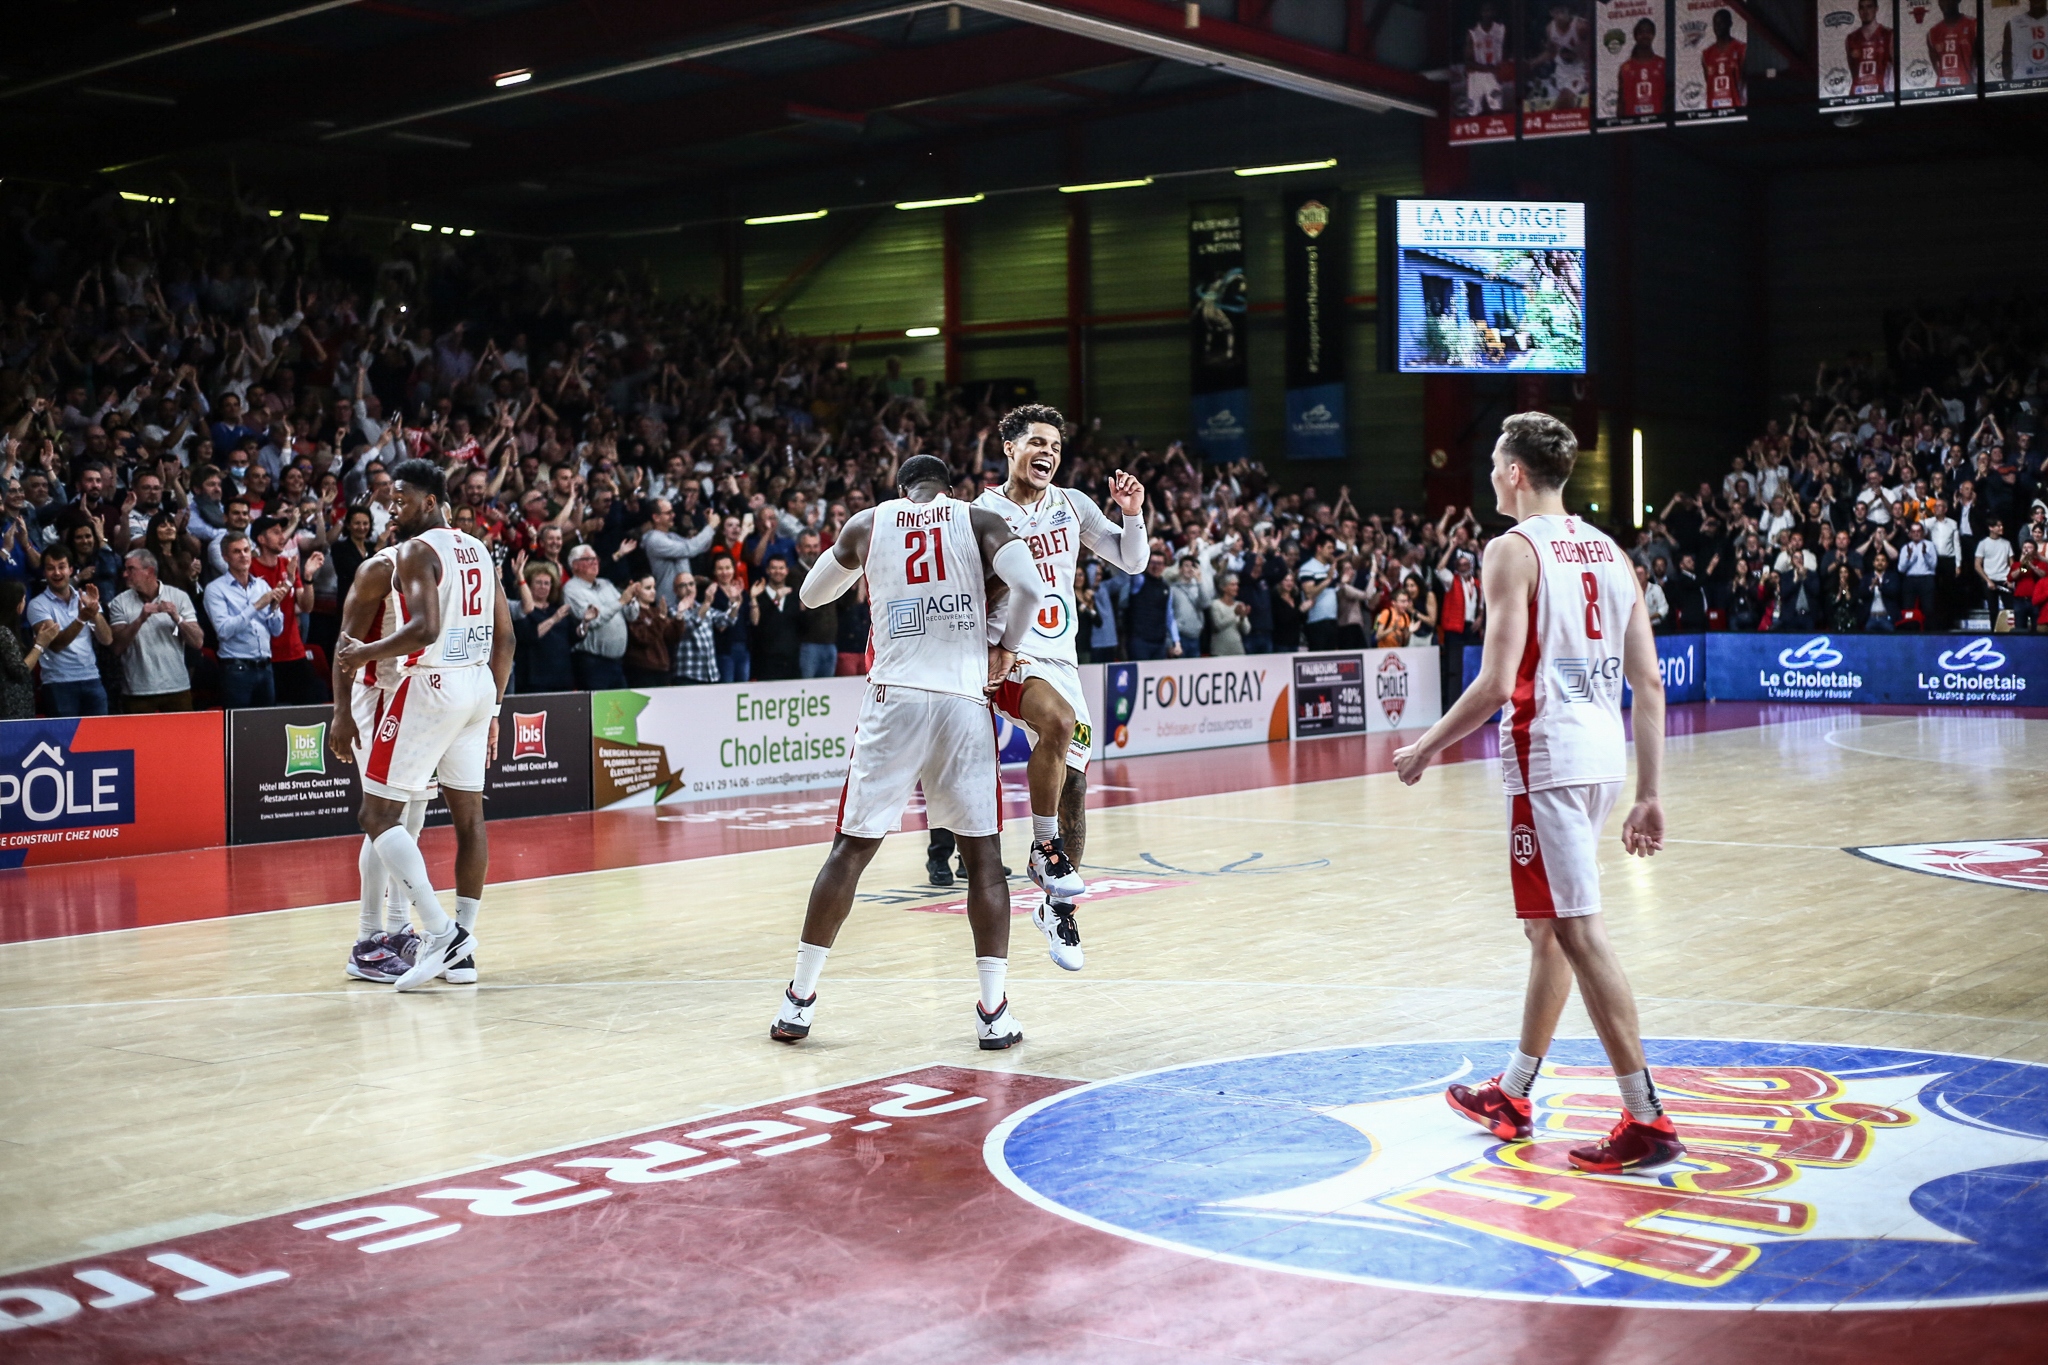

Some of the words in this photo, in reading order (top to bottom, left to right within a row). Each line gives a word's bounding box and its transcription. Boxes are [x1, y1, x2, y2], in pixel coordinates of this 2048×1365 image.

[1862, 47, 1875, 59] 12
[1416, 207, 1445, 226] LA
[1455, 207, 1567, 229] SALORGE
[905, 527, 946, 585] 21
[460, 568, 482, 617] 12
[926, 593, 973, 614] AGIR
[1581, 571, 1603, 640] 8
[926, 613, 974, 622] RECOUVREMENT
[958, 621, 975, 631] FSP
[1037, 605, 1059, 629] U
[1377, 672, 1408, 699] CHOLET
[1760, 669, 1780, 687] Le
[1783, 670, 1862, 688] Choletais
[1918, 672, 1940, 689] Le
[1943, 673, 2026, 690] Choletais
[876, 685, 886, 703] 21
[1143, 670, 1266, 710] FOUGERAY
[1338, 687, 1361, 704] -10%
[1966, 691, 1984, 702] pour
[1986, 691, 2016, 701] réussir
[736, 689, 830, 727] Energies
[384, 722, 396, 738] CB
[519, 724, 541, 743] ibis
[1157, 720, 1197, 737] bâtisseur
[1199, 716, 1253, 733] d'assurances
[295, 734, 316, 750] ibis
[720, 732, 846, 768] Choletaises
[502, 763, 517, 773] Hôtel
[517, 762, 528, 772] IBIS
[259, 782, 277, 792] Hôtel
[278, 781, 291, 790] IBIS
[693, 782, 703, 793] 02
[705, 781, 715, 791] 41
[717, 779, 727, 790] 29
[730, 778, 739, 788] 14
[740, 777, 749, 788] 06
[264, 793, 299, 803] Restaurant
[299, 792, 308, 800] LA
[9, 832, 63, 846] CONSTRUIT
[65, 830, 90, 841] CHEZ
[92, 828, 119, 840] NOUS
[1514, 833, 1532, 856] CB
